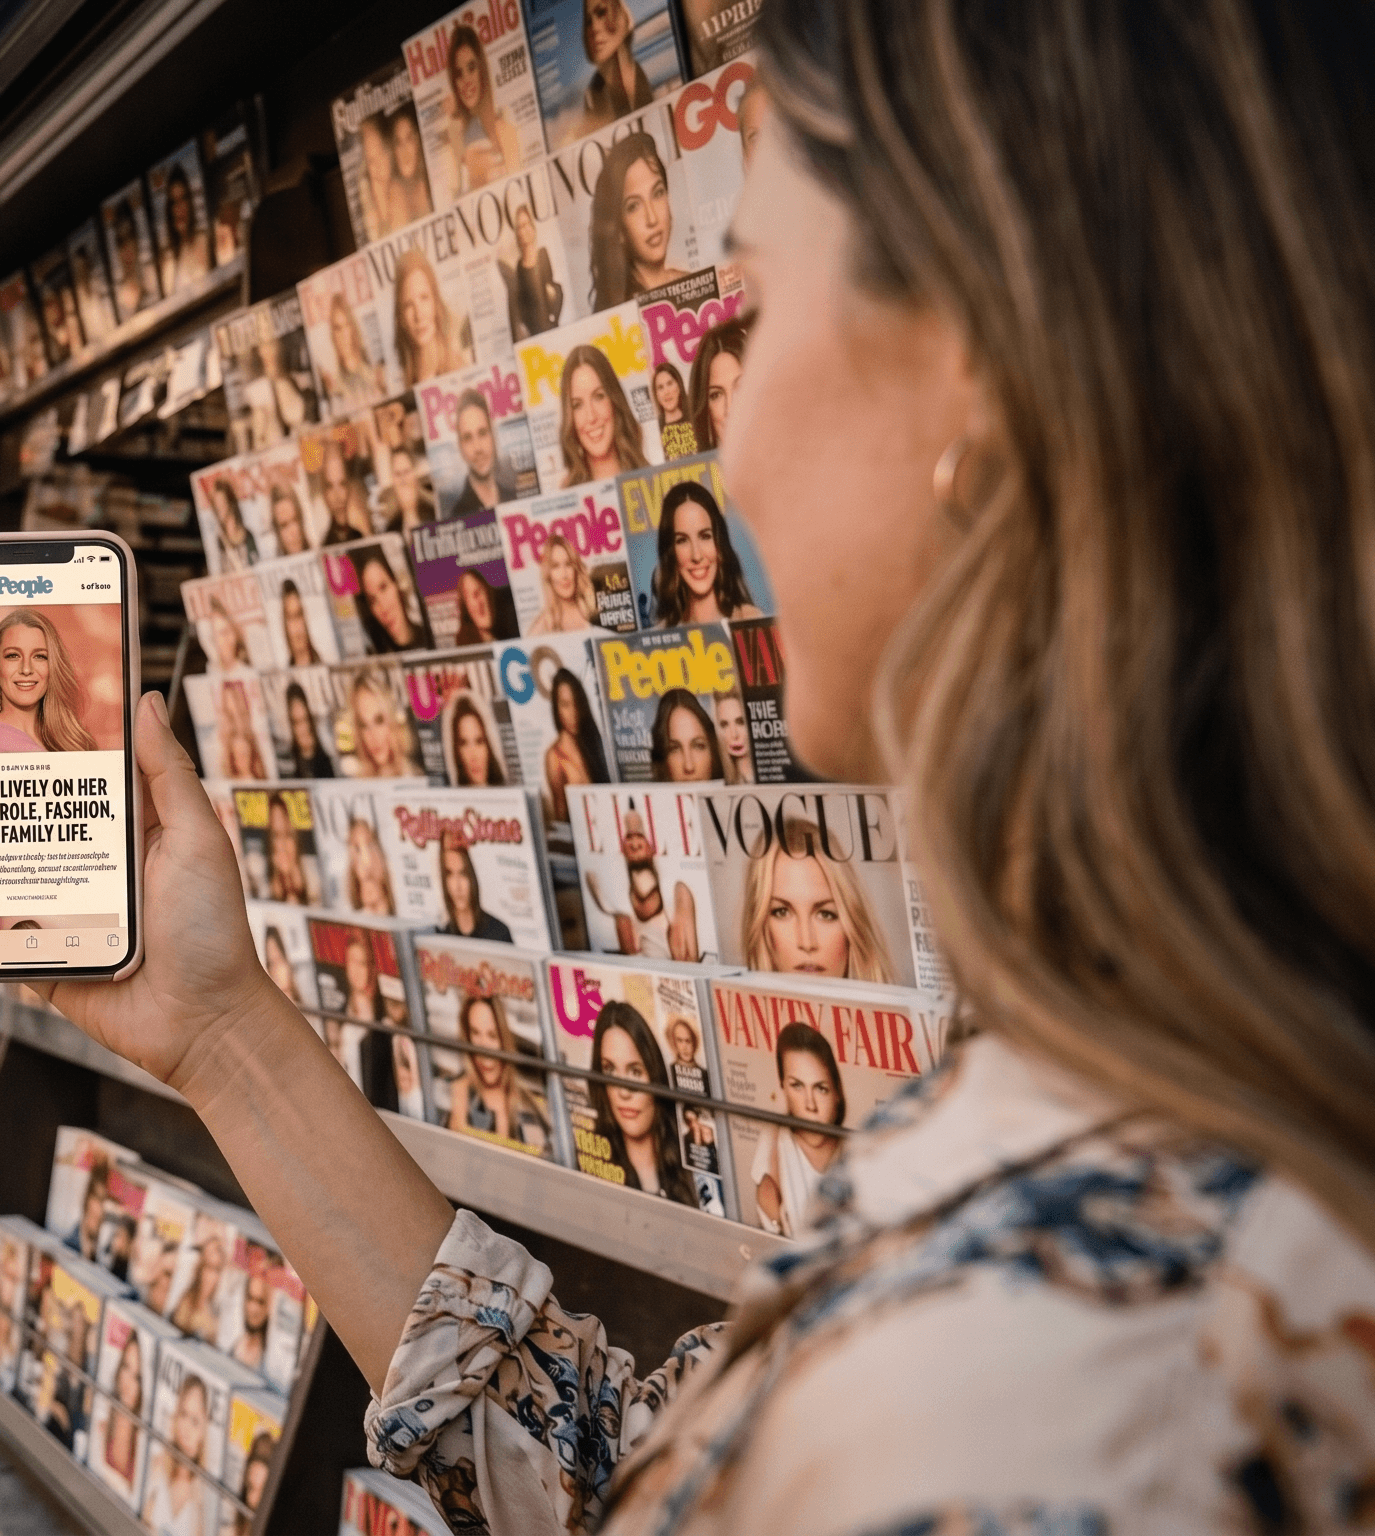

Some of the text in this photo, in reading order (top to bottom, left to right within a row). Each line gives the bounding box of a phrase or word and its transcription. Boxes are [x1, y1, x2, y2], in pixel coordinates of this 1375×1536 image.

[600, 630, 736, 702] People
[0, 778, 49, 798] LIVELY
[52, 778, 73, 797] ON
[78, 777, 107, 796] HER
[0, 802, 42, 822] ROLE,
[45, 800, 115, 821] FASHION,
[1, 824, 54, 843] FAMILY
[58, 823, 93, 842] LIFE.
[703, 792, 898, 863] VOGUE
[715, 988, 825, 1053] VANITY
[831, 1005, 921, 1075] FAIR
